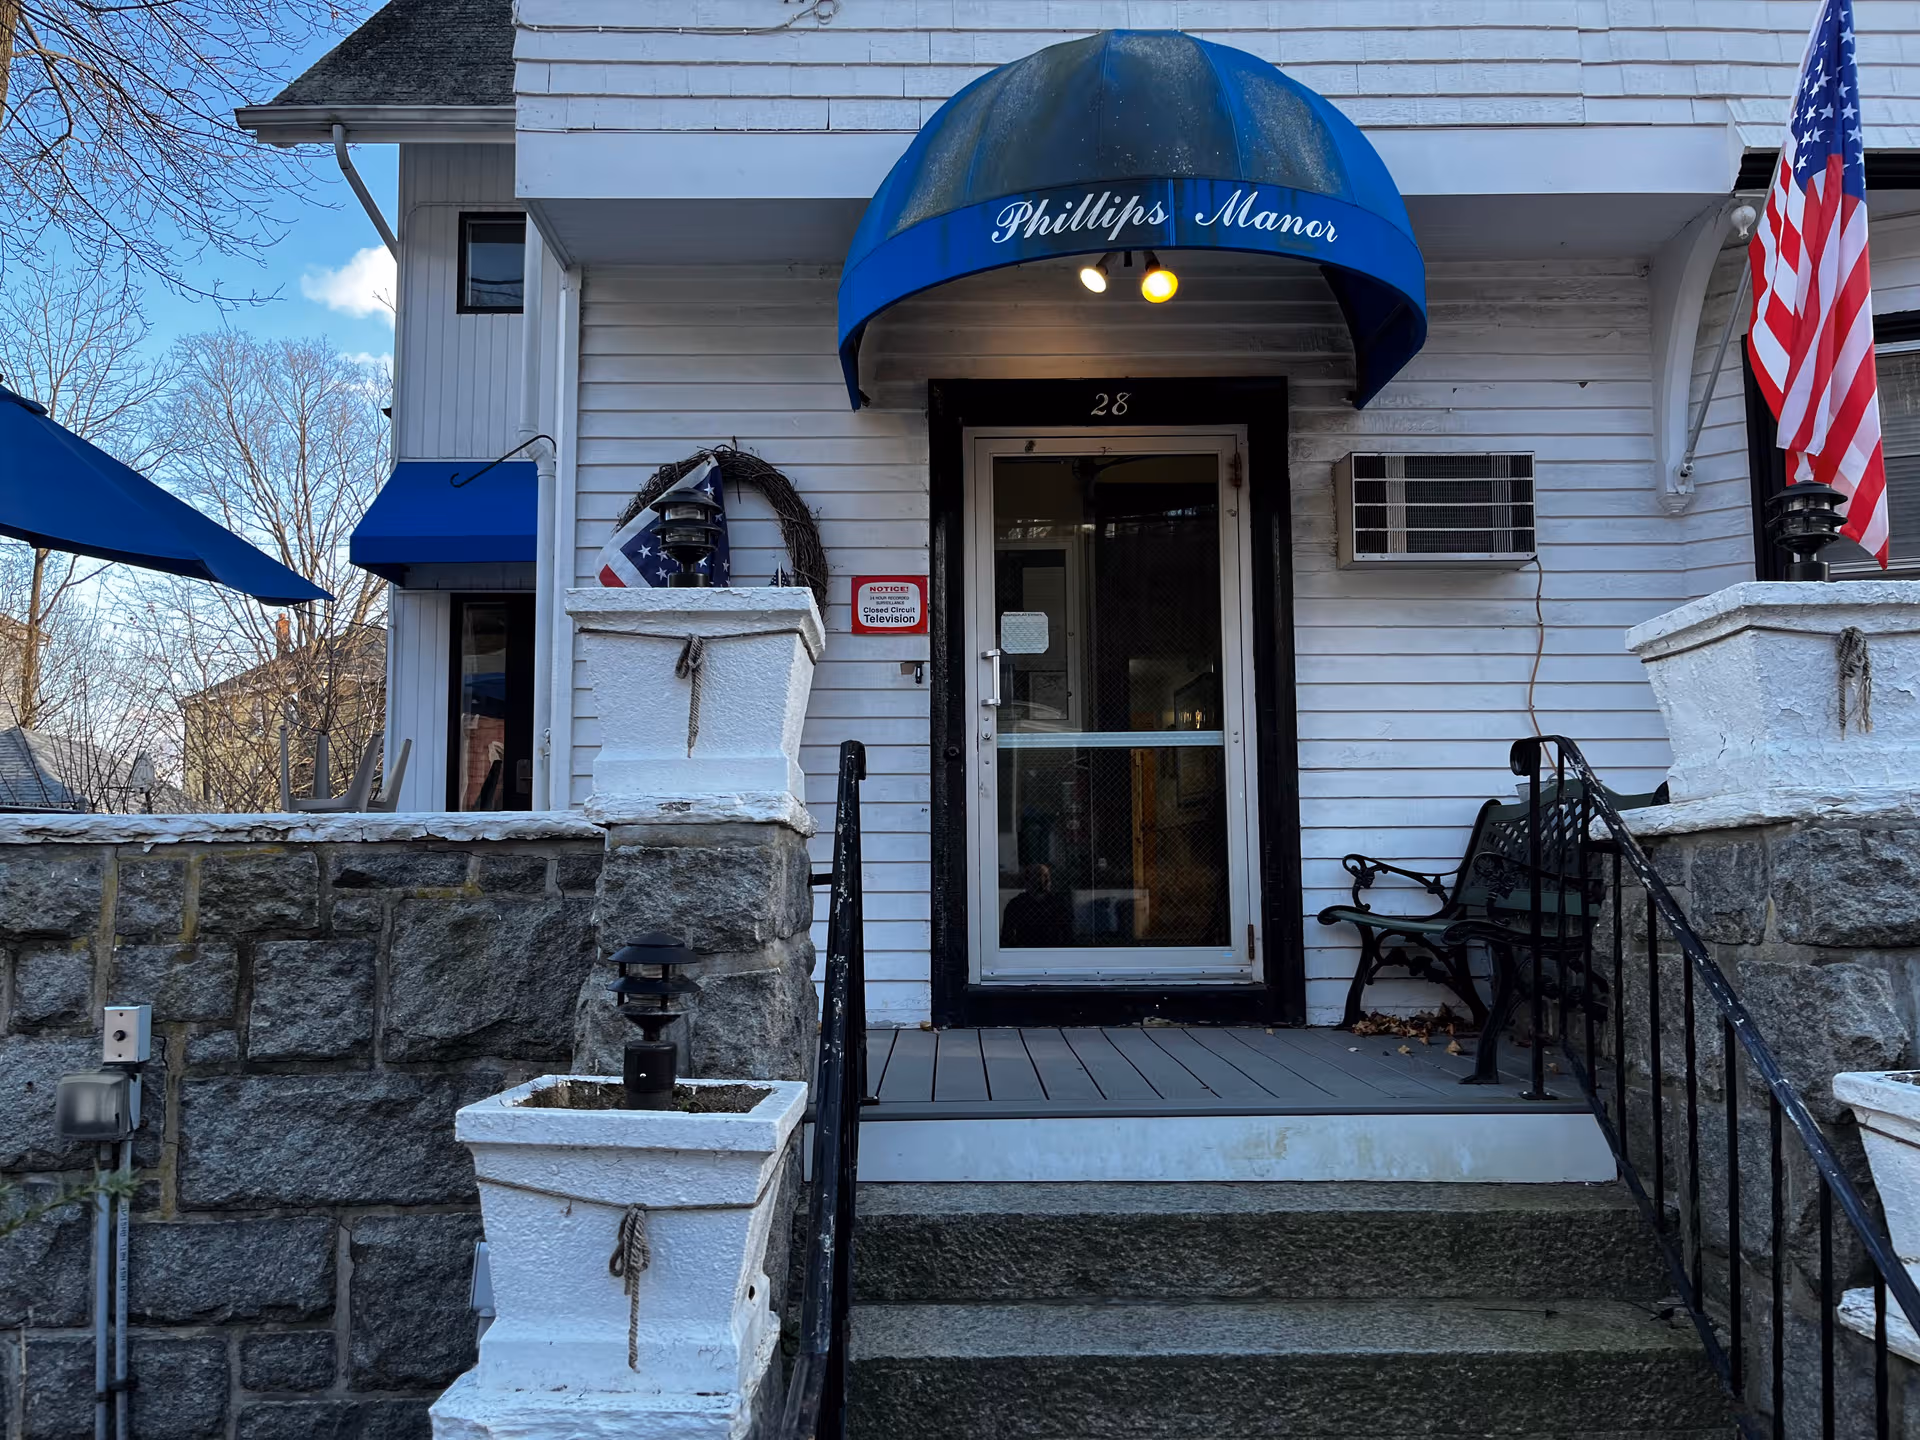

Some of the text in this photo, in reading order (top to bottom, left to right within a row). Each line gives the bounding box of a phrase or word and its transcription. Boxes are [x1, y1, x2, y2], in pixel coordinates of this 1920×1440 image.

[991, 189, 1338, 244] Phillips Manor
[1091, 392, 1132, 416] 28
[864, 614, 916, 623] Television
